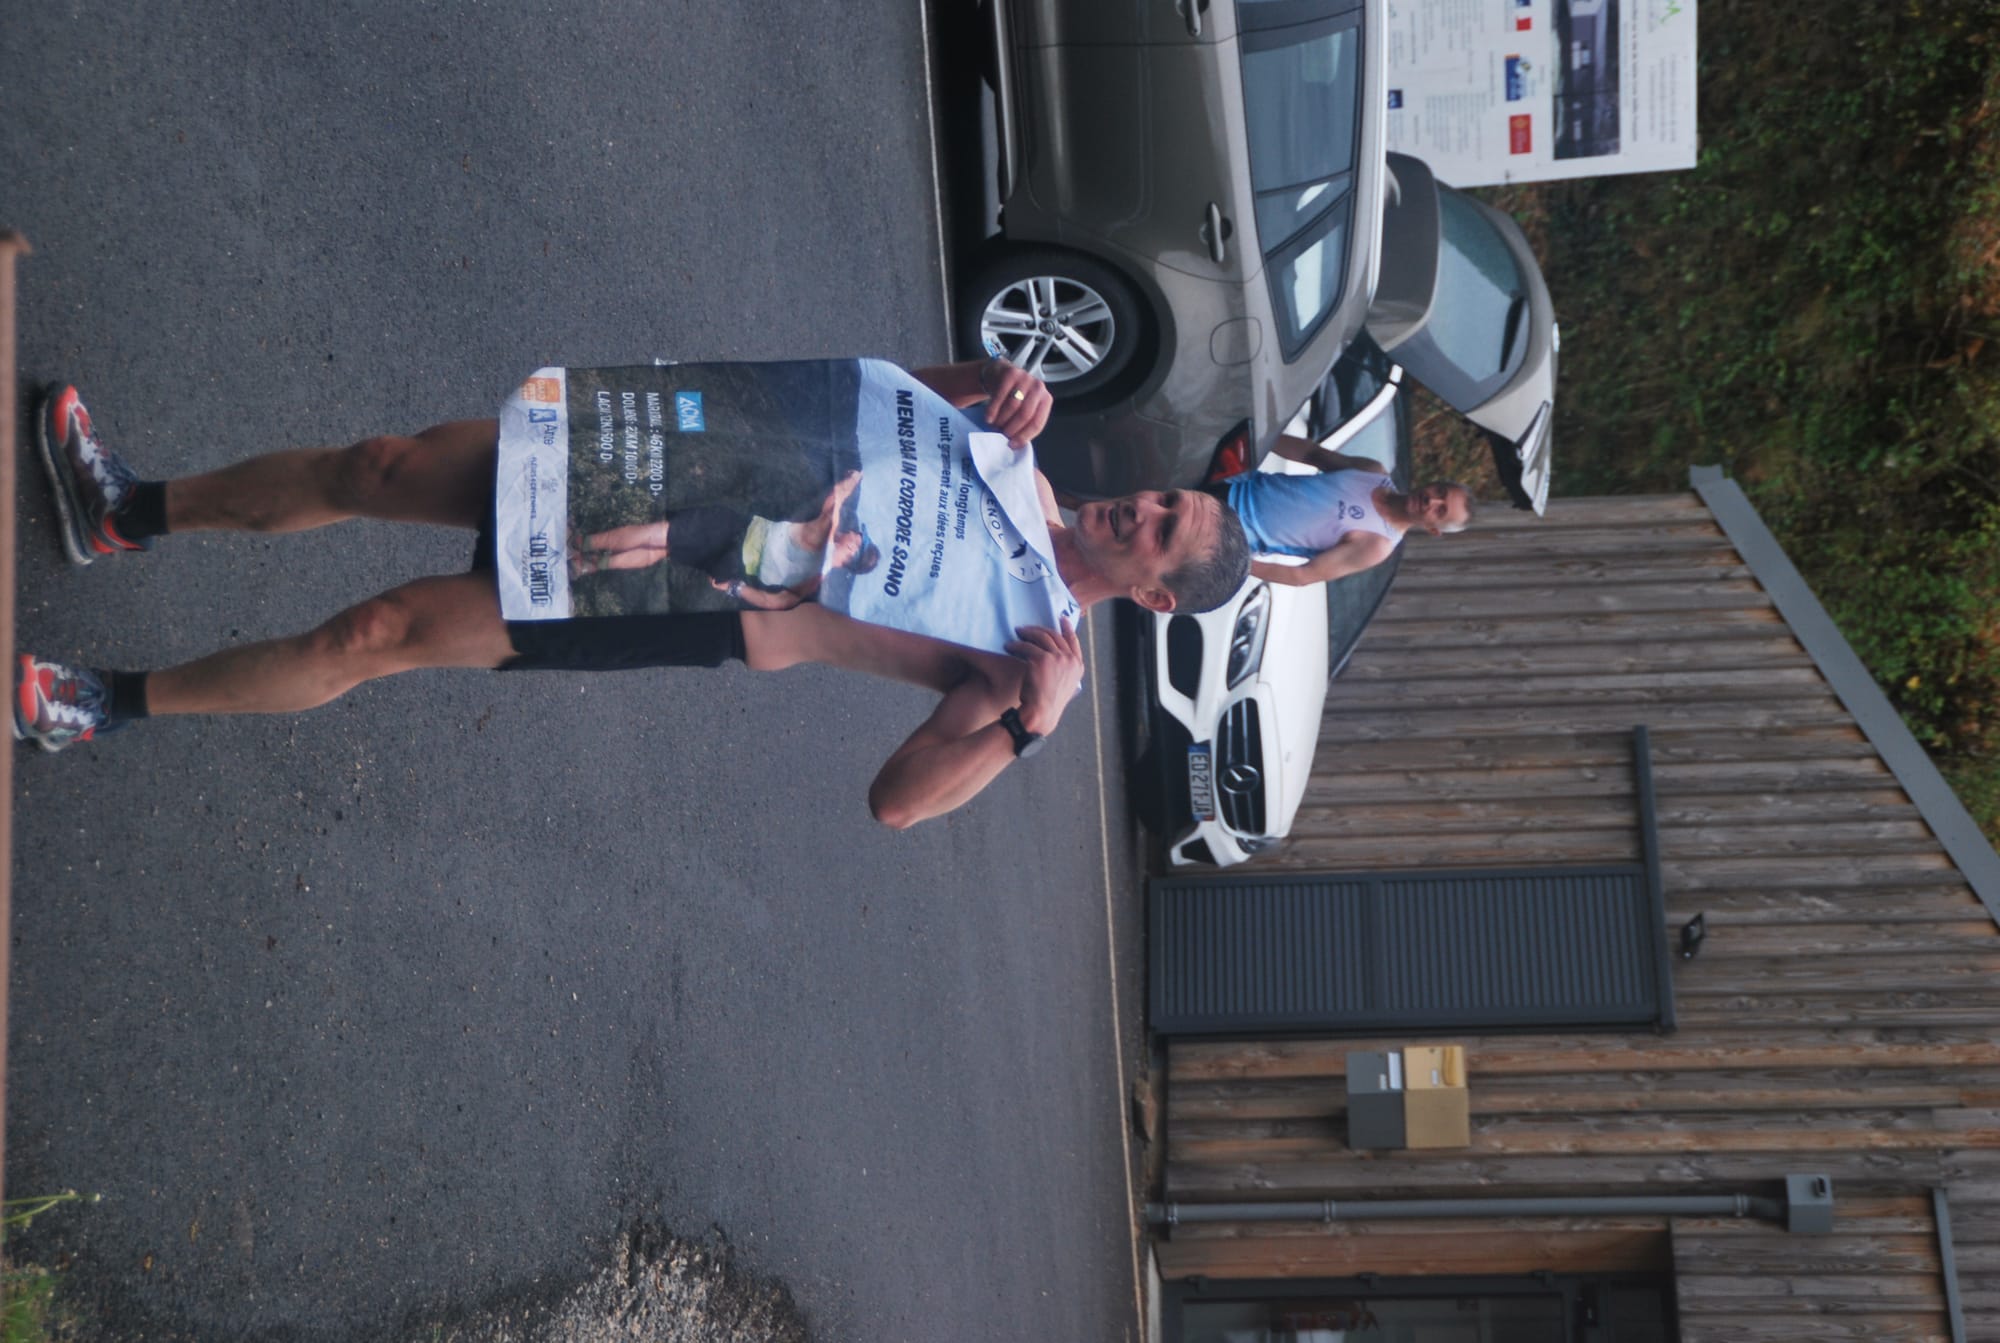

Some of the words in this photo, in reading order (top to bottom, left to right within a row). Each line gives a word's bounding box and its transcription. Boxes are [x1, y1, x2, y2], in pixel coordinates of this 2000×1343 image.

[896, 390, 915, 438] MENS
[939, 417, 954, 442] nuit
[901, 460, 918, 477] IN
[894, 478, 917, 546] CORPORE
[937, 489, 950, 509] aux
[954, 483, 974, 540] longtemps
[935, 511, 950, 539] idées
[883, 546, 908, 597] SANO
[928, 538, 944, 578] reçues
